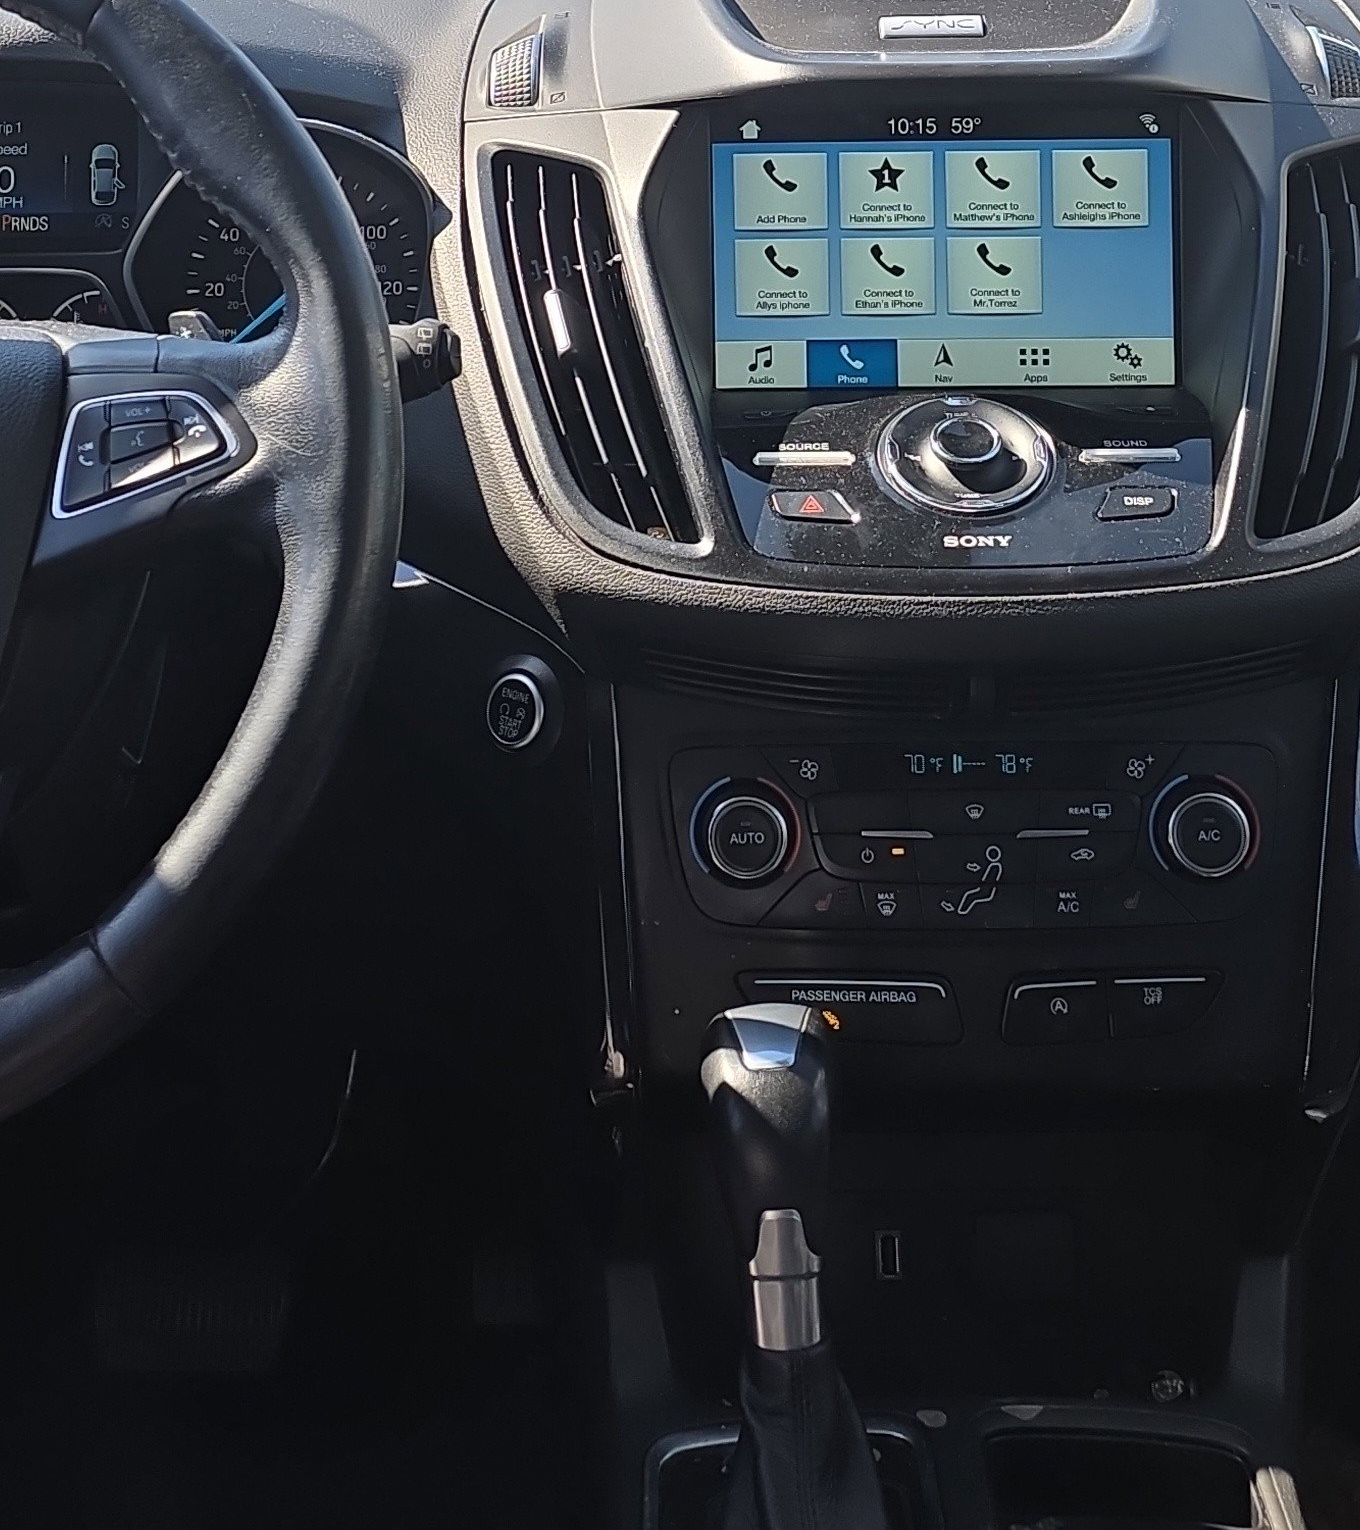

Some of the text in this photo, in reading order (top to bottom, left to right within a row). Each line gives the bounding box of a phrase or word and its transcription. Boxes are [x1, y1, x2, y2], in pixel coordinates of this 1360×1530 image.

[890, 18, 976, 30] SYNC
[15, 122, 22, 133] 1
[888, 117, 982, 135] 10:15 59°
[862, 203, 912, 212] Connect to
[968, 202, 1019, 211] Connect to
[1075, 201, 1127, 210] Connect to
[756, 214, 807, 224] Add Phone
[849, 213, 926, 223] Hannah's iPhone
[953, 212, 1035, 222] Matthew's iPhone
[1062, 211, 1141, 222] Ashleighs iPhone
[2, 214, 49, 232] PRNDS
[219, 227, 240, 242] 40
[233, 246, 246, 256] 60
[225, 273, 237, 283] 40
[204, 282, 225, 297] 20
[757, 290, 808, 299] Connect to
[863, 289, 914, 298] Connect to
[970, 288, 1021, 297] Connect to
[227, 300, 239, 310] 20
[755, 300, 777, 311] Allys
[855, 299, 924, 309] Ethan's iPhone
[748, 375, 775, 385] Audio
[837, 374, 869, 384] Phone
[934, 374, 954, 383] Nav
[1023, 373, 1049, 384] Apps
[1109, 372, 1148, 384] Settings
[778, 442, 830, 451] SOURCE
[1103, 439, 1148, 448] SOUND
[1123, 496, 1154, 506] DISP
[943, 535, 1013, 548] SONY
[501, 687, 531, 705] ENGINE
[498, 715, 522, 730] START
[498, 725, 518, 738] STOP
[1068, 807, 1090, 815] REAR
[729, 832, 765, 845] AUTO
[1198, 830, 1221, 842] A/C
[877, 892, 895, 900] MAX
[1059, 891, 1077, 899] MAX
[1057, 901, 1080, 913] A/C
[791, 989, 917, 1002] PASSENGER AIRBAG
[1143, 987, 1163, 996] TCS
[1143, 996, 1163, 1005] OFF
